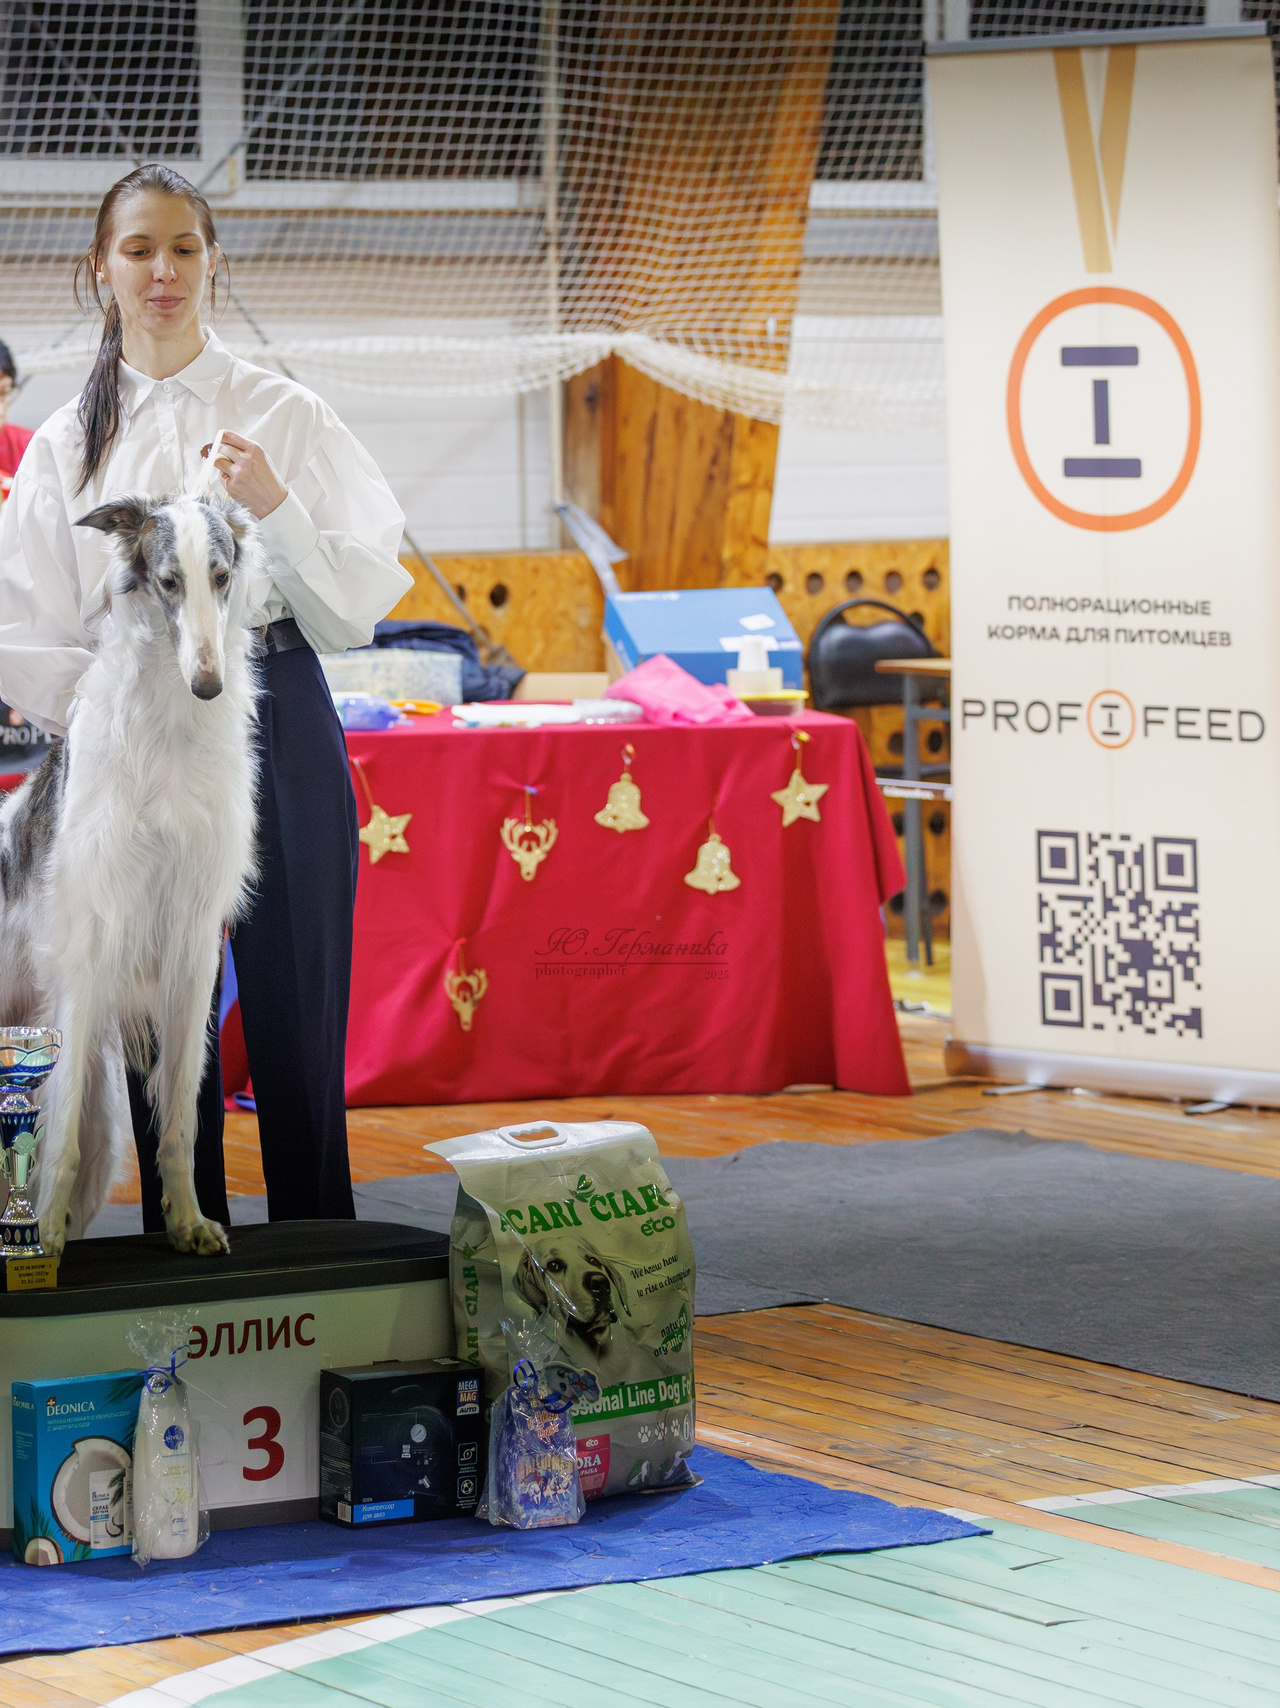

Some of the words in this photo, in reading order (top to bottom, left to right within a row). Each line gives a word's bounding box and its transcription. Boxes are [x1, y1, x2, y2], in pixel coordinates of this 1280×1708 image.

[1008, 596, 1212, 616] ПОЛНОРАЦИОННЫЕ
[987, 624, 1061, 642] КОРМА
[1065, 627, 1110, 645] ДЛЯ
[1115, 628, 1232, 648] ПИТОМЦЕВ
[589, 1183, 670, 1222] CIAR
[640, 1215, 675, 1237] eco
[630, 1267, 644, 1280] We
[644, 1260, 662, 1275] know
[663, 1254, 678, 1267] how
[462, 1265, 479, 1317] CIAR
[644, 1283, 659, 1295] rise
[659, 1281, 664, 1289] a
[664, 1268, 691, 1287] champion
[187, 1312, 316, 1360] ЭЛЛИС
[660, 1312, 687, 1338] natural
[654, 1333, 683, 1358] organic
[458, 1380, 478, 1391] MEGA
[460, 1391, 477, 1402] MAG
[627, 1386, 656, 1408] Line
[658, 1380, 680, 1404] Dog
[47, 1401, 95, 1417] DEONICA
[242, 1405, 285, 1482] 3
[585, 1439, 599, 1448] eco
